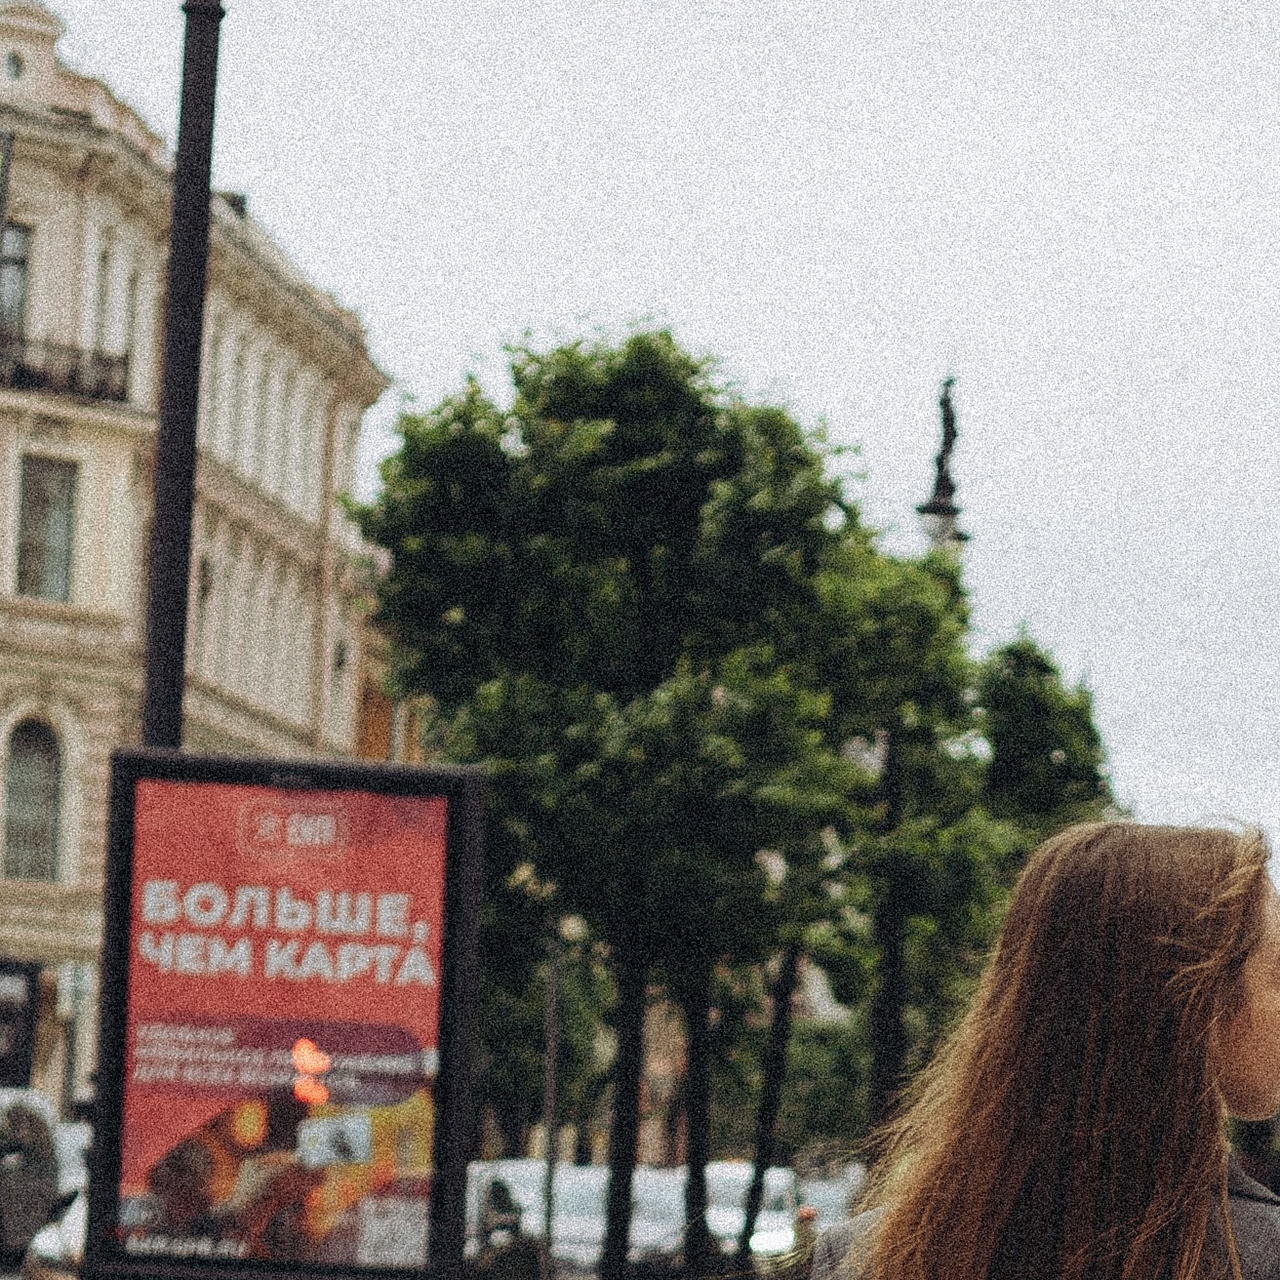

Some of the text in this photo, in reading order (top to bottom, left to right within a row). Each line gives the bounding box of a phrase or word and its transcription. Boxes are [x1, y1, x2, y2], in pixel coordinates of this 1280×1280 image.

[141, 879, 430, 943] БОЛЬШЕ,
[139, 931, 437, 985] ЧЕМ КАРТА
